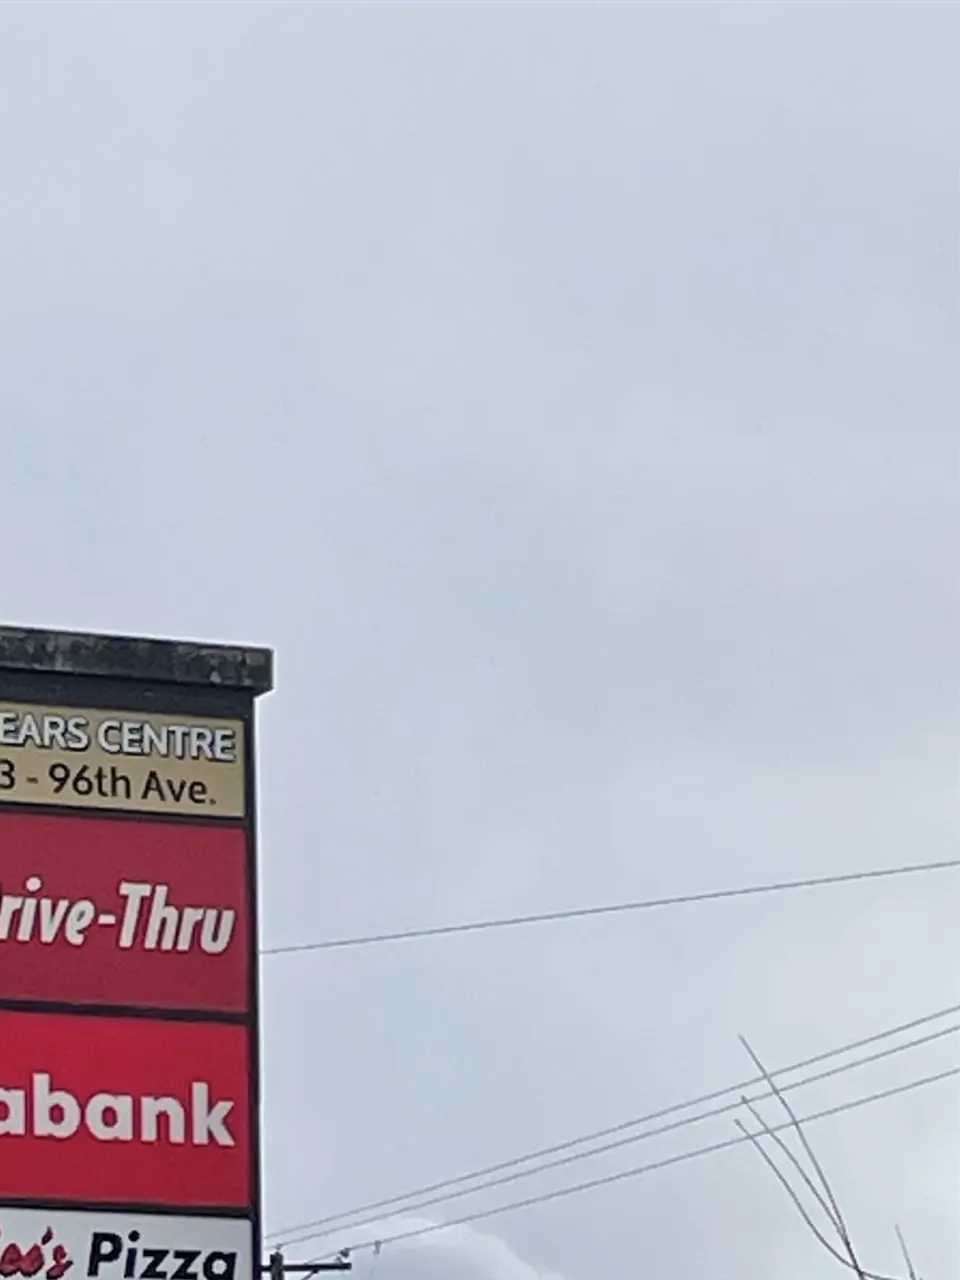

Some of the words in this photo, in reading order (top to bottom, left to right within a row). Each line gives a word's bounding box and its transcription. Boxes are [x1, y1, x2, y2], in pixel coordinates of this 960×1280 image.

[97, 719, 237, 763] CENTRE
[48, 763, 131, 799] 96th
[141, 770, 217, 806] Ave.
